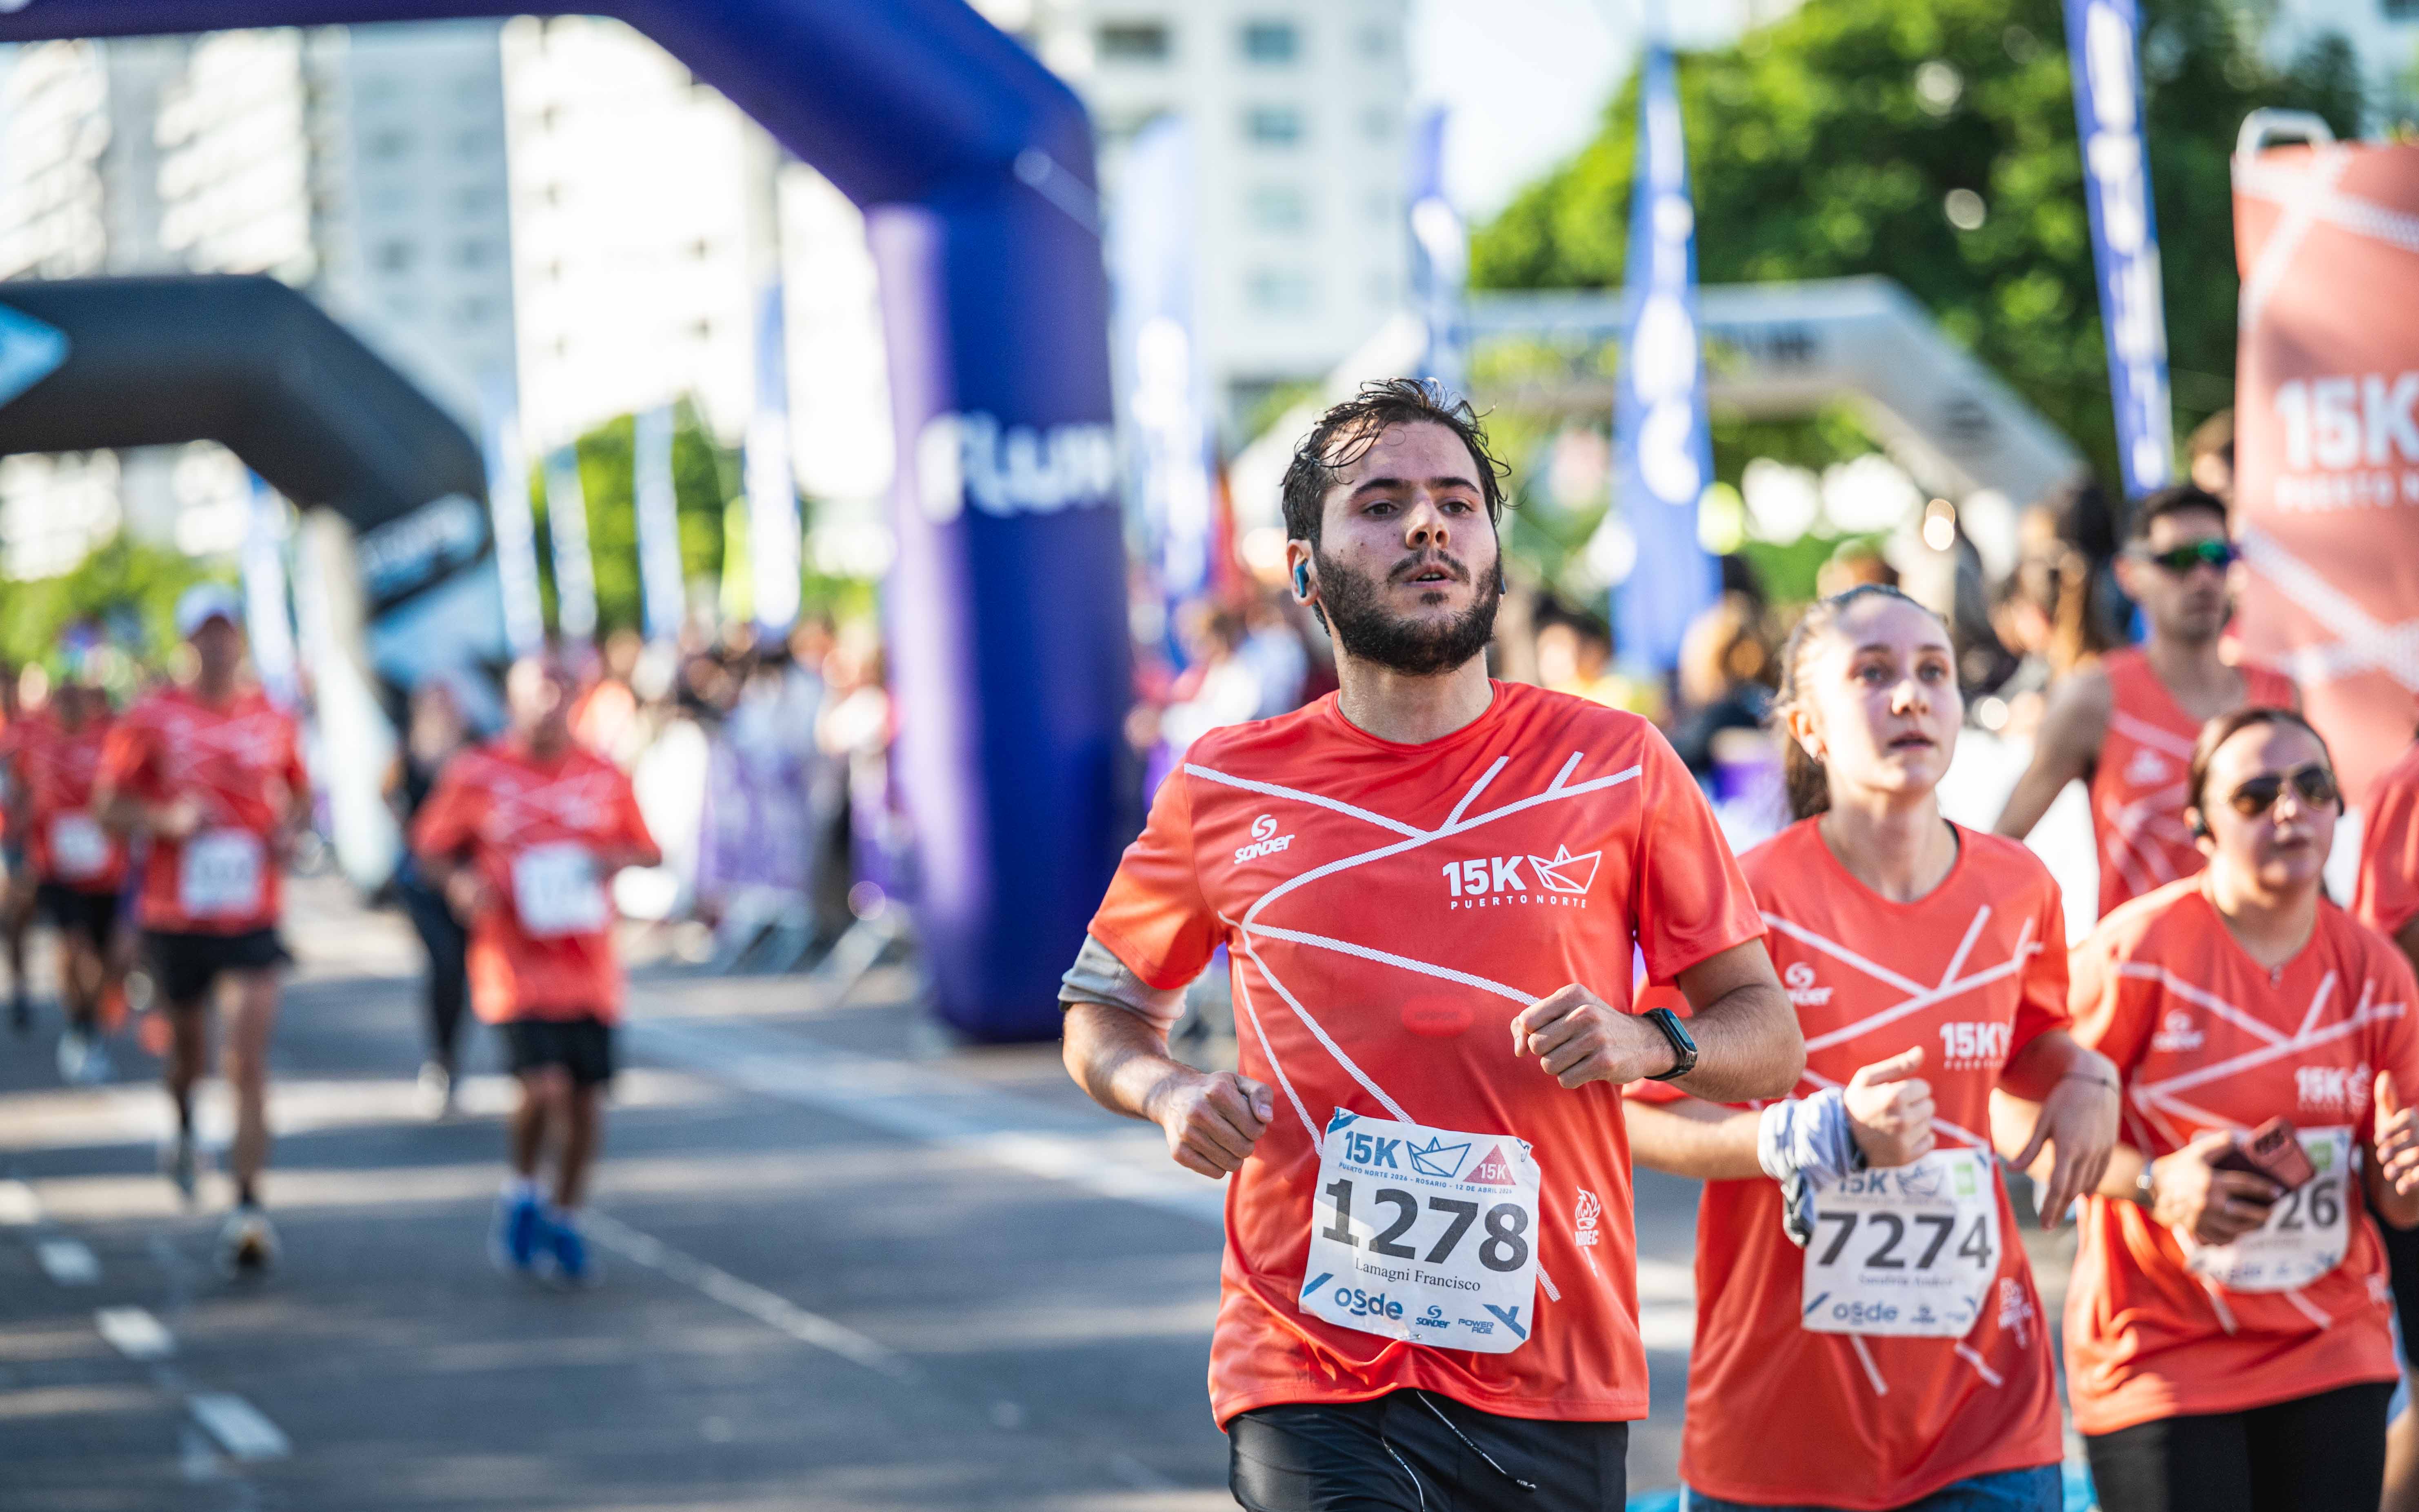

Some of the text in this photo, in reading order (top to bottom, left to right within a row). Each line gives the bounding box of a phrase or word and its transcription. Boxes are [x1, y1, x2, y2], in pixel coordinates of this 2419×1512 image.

[2275, 372, 2419, 470] 15K
[1443, 856, 1527, 897] 15K
[1451, 895, 1586, 910] PUERTO NORTE
[1939, 1022, 1997, 1058] 15K
[1345, 1130, 1401, 1169] 15K
[1339, 1162, 1362, 1174] PUERTO
[1364, 1169, 1388, 1178] NORTE
[1415, 1178, 1446, 1188] ROSARIO
[1479, 1162, 1506, 1180] 15K
[1322, 1178, 1528, 1272] 1278
[1817, 1211, 1992, 1270] 7274
[1355, 1257, 1481, 1292] Lamagni Francisco
[1334, 1287, 1403, 1320] osde
[1458, 1318, 1494, 1328] POWER
